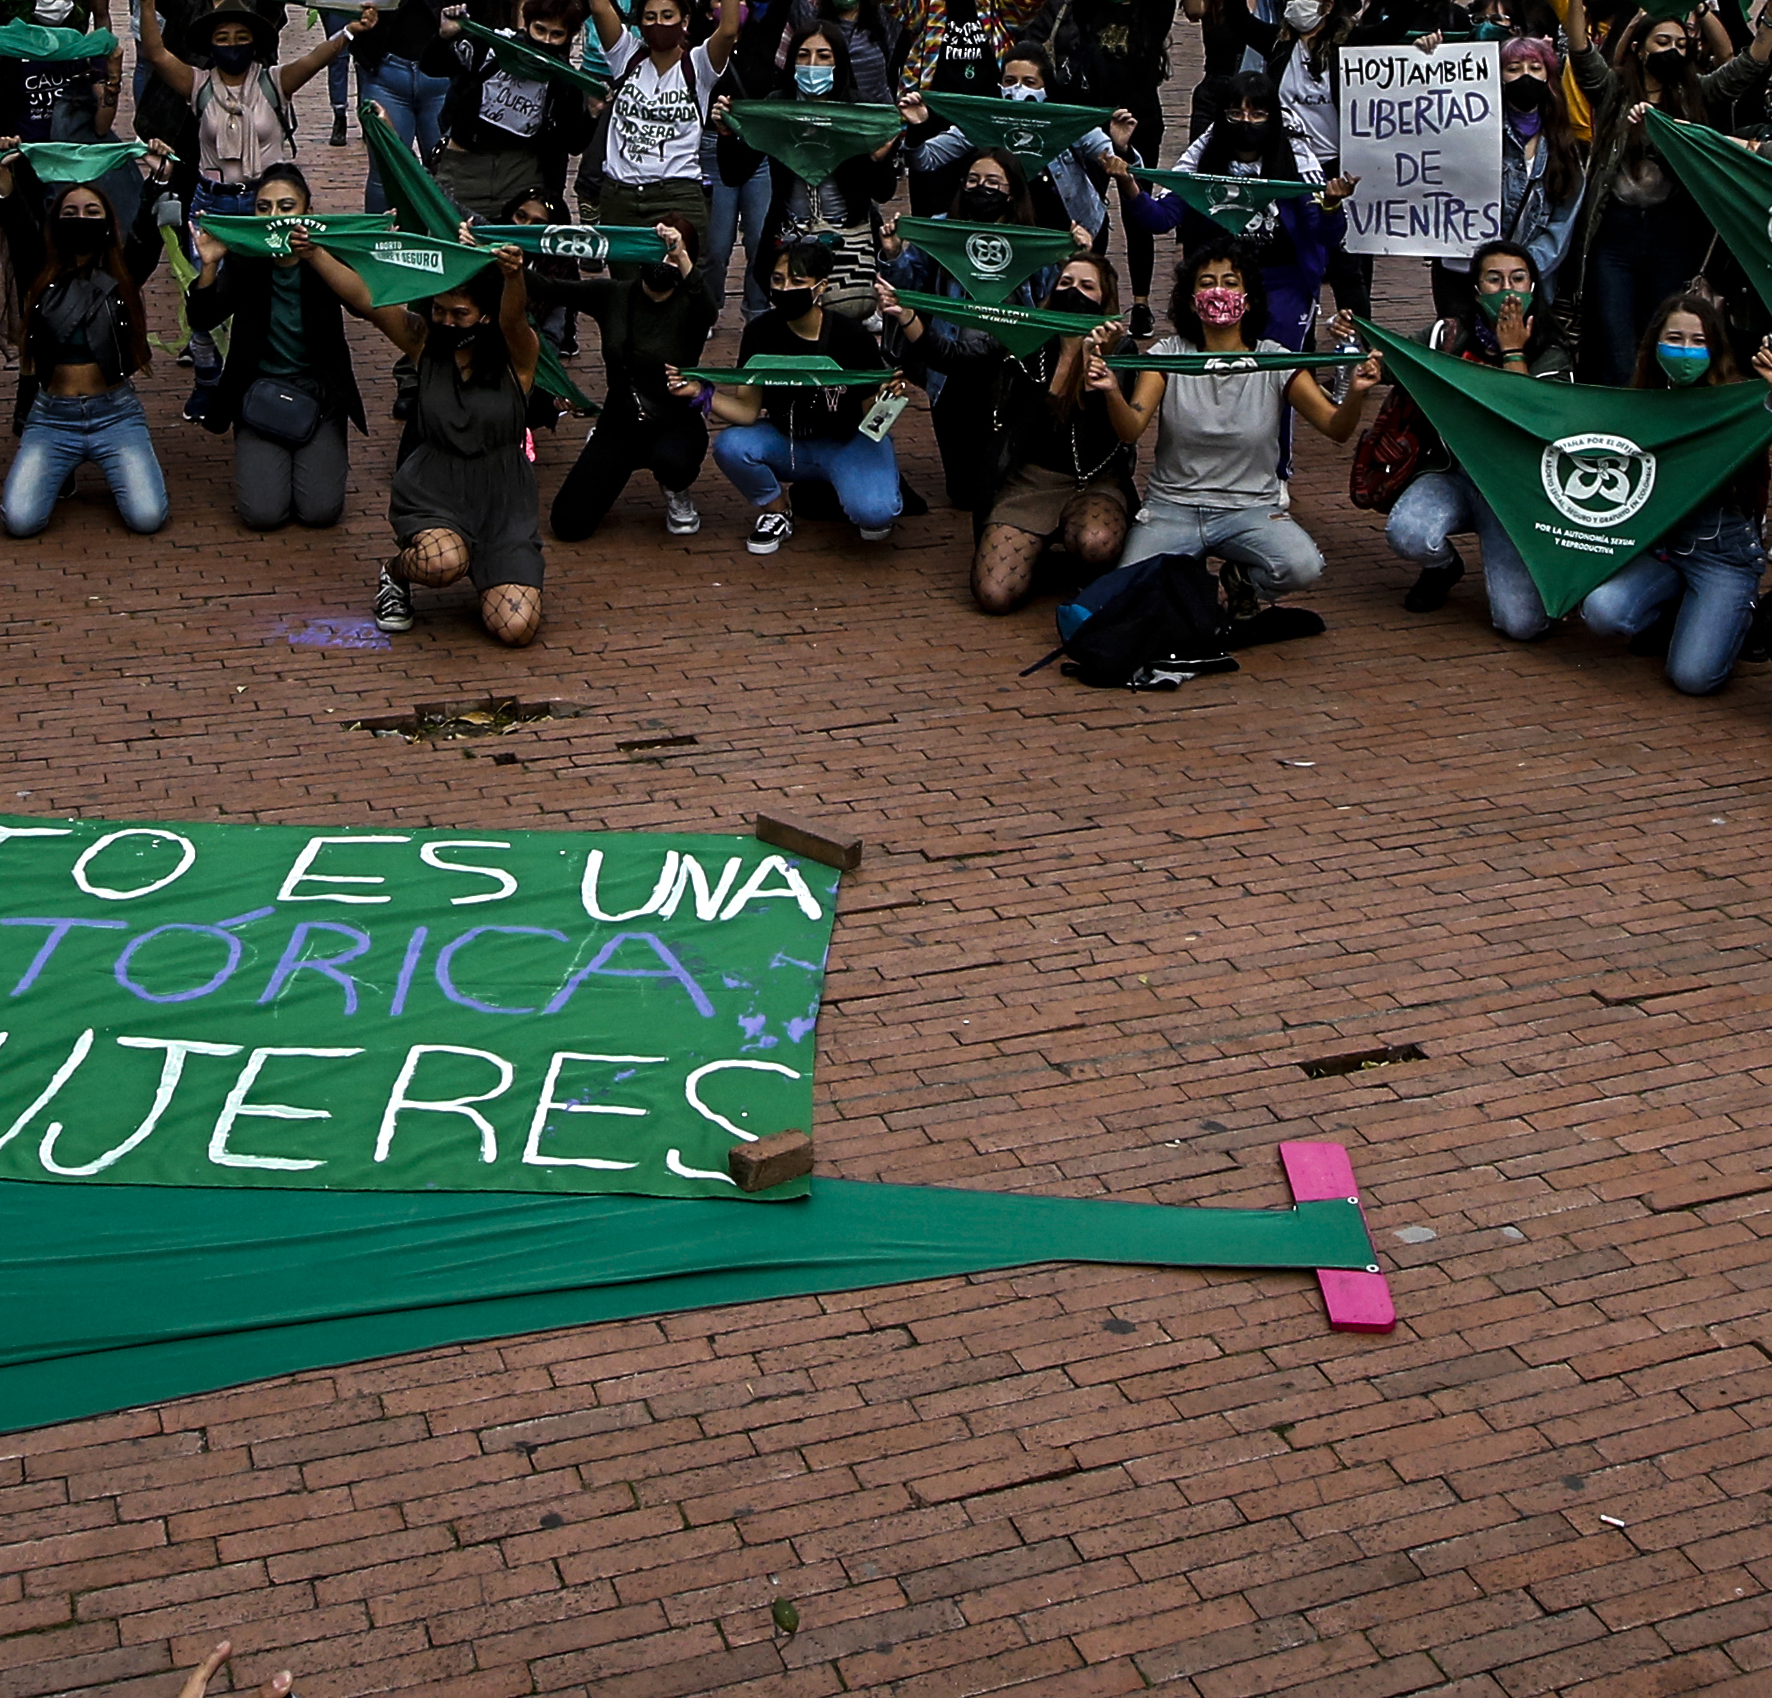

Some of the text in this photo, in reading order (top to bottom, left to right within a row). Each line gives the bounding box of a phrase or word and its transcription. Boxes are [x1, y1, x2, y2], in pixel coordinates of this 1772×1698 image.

[1350, 90, 1489, 139] LIBERTAD
[1396, 150, 1444, 187] DE
[1348, 191, 1500, 242] VIENTRES
[1535, 521, 1551, 533] POR
[1552, 526, 1563, 536] LA
[278, 835, 518, 905] ES
[579, 846, 823, 924] UNA
